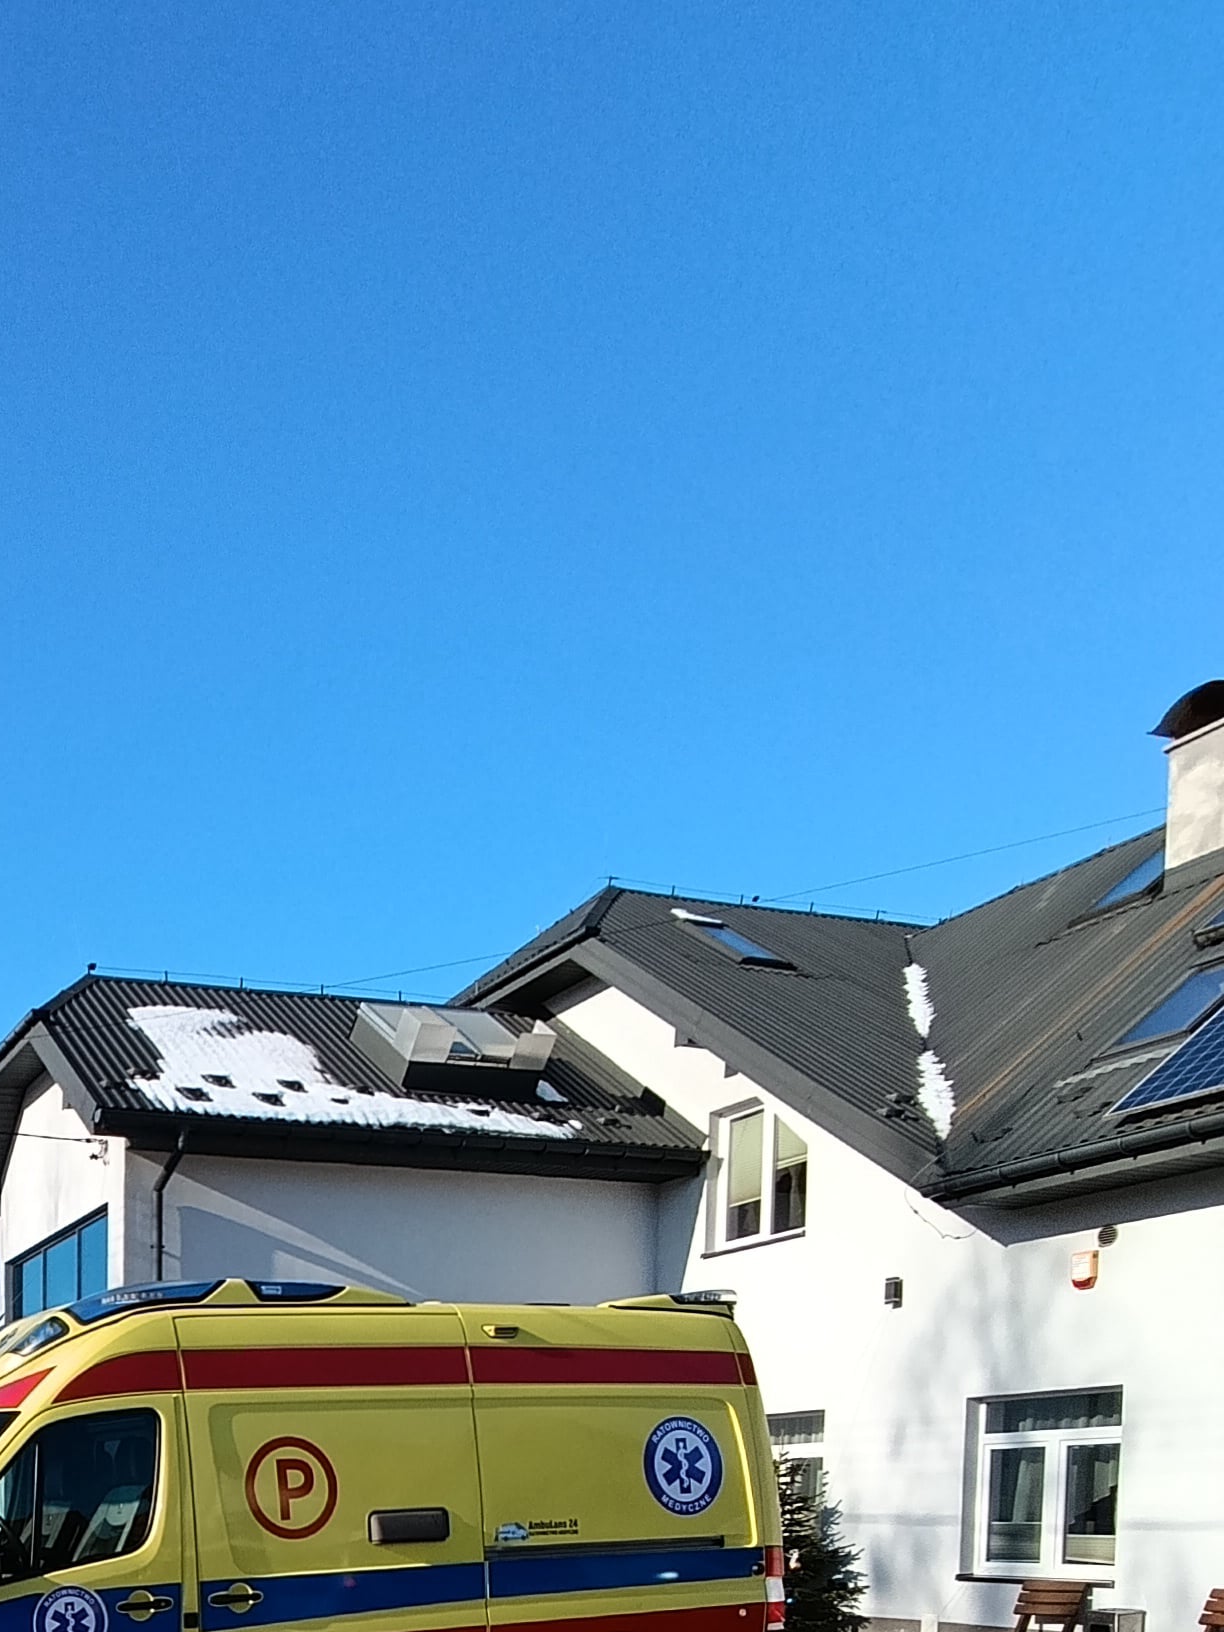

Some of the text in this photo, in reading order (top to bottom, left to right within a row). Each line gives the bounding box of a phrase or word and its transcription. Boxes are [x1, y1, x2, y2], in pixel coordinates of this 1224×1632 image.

[651, 1420, 710, 1443] RATOWNICTWO
[276, 1458, 314, 1520] P
[661, 1494, 712, 1512] MEDYCZNE
[43, 1588, 95, 1607] RATOWNICTWO
